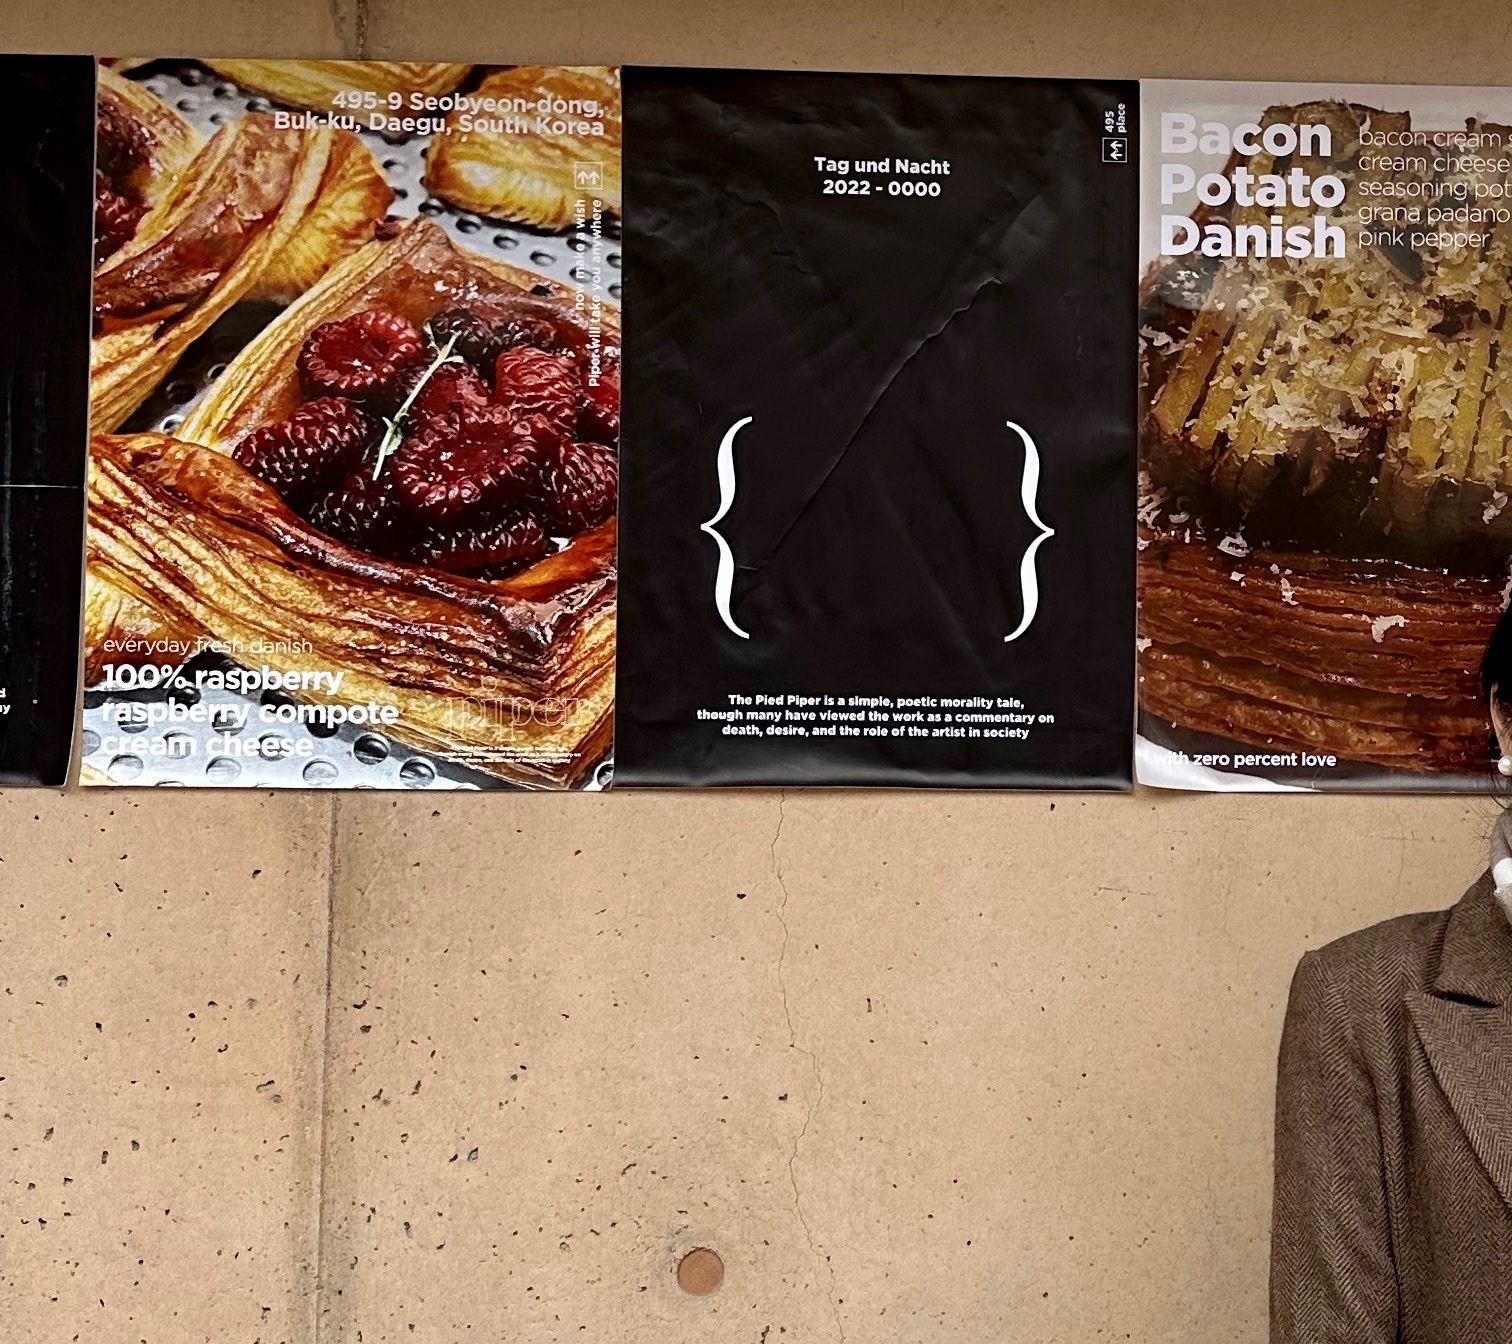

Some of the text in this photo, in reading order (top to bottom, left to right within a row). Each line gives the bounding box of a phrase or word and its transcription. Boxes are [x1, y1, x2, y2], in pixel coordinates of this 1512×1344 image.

[331, 92, 604, 119] 495-9 Seobyeon-dong,
[274, 111, 605, 136] Buk-ku, Daegu, South Korea
[1104, 110, 1114, 132] 495
[1116, 103, 1127, 133] place
[1160, 112, 1331, 156] Bacon
[1359, 130, 1426, 146] bacon
[1434, 134, 1501, 148] cream
[814, 157, 950, 174] Tag und Nacht
[1359, 155, 1510, 172] cream cheese
[823, 180, 870, 194] 2022
[888, 181, 941, 196] 0000
[1160, 164, 1346, 208] Potato
[1358, 179, 1468, 200] seasoning
[1358, 207, 1421, 225] grana
[1428, 205, 1510, 225] padano
[1160, 215, 1346, 258] Danish
[1358, 228, 1491, 250] pink pepper
[576, 199, 585, 310] now make a wish
[588, 200, 602, 387] Piper will take you anywhere
[103, 638, 312, 656] everyday fresh danish
[102, 664, 343, 696] 100% raspberry
[102, 697, 399, 727] raspberry compote
[728, 695, 752, 705] The
[756, 695, 784, 705] Pied
[787, 695, 821, 707] Piper
[824, 695, 834, 705] is
[849, 696, 893, 708] simple,
[897, 697, 937, 708] poetic
[941, 697, 993, 709] morality
[997, 698, 1024, 709] tale,
[697, 709, 1054, 724] though many have viewed the work as a commentary on
[722, 724, 1029, 739] death, desire, and the role of the artist in society
[101, 731, 313, 757] cream cheese
[1154, 752, 1336, 768] with zero percent love
